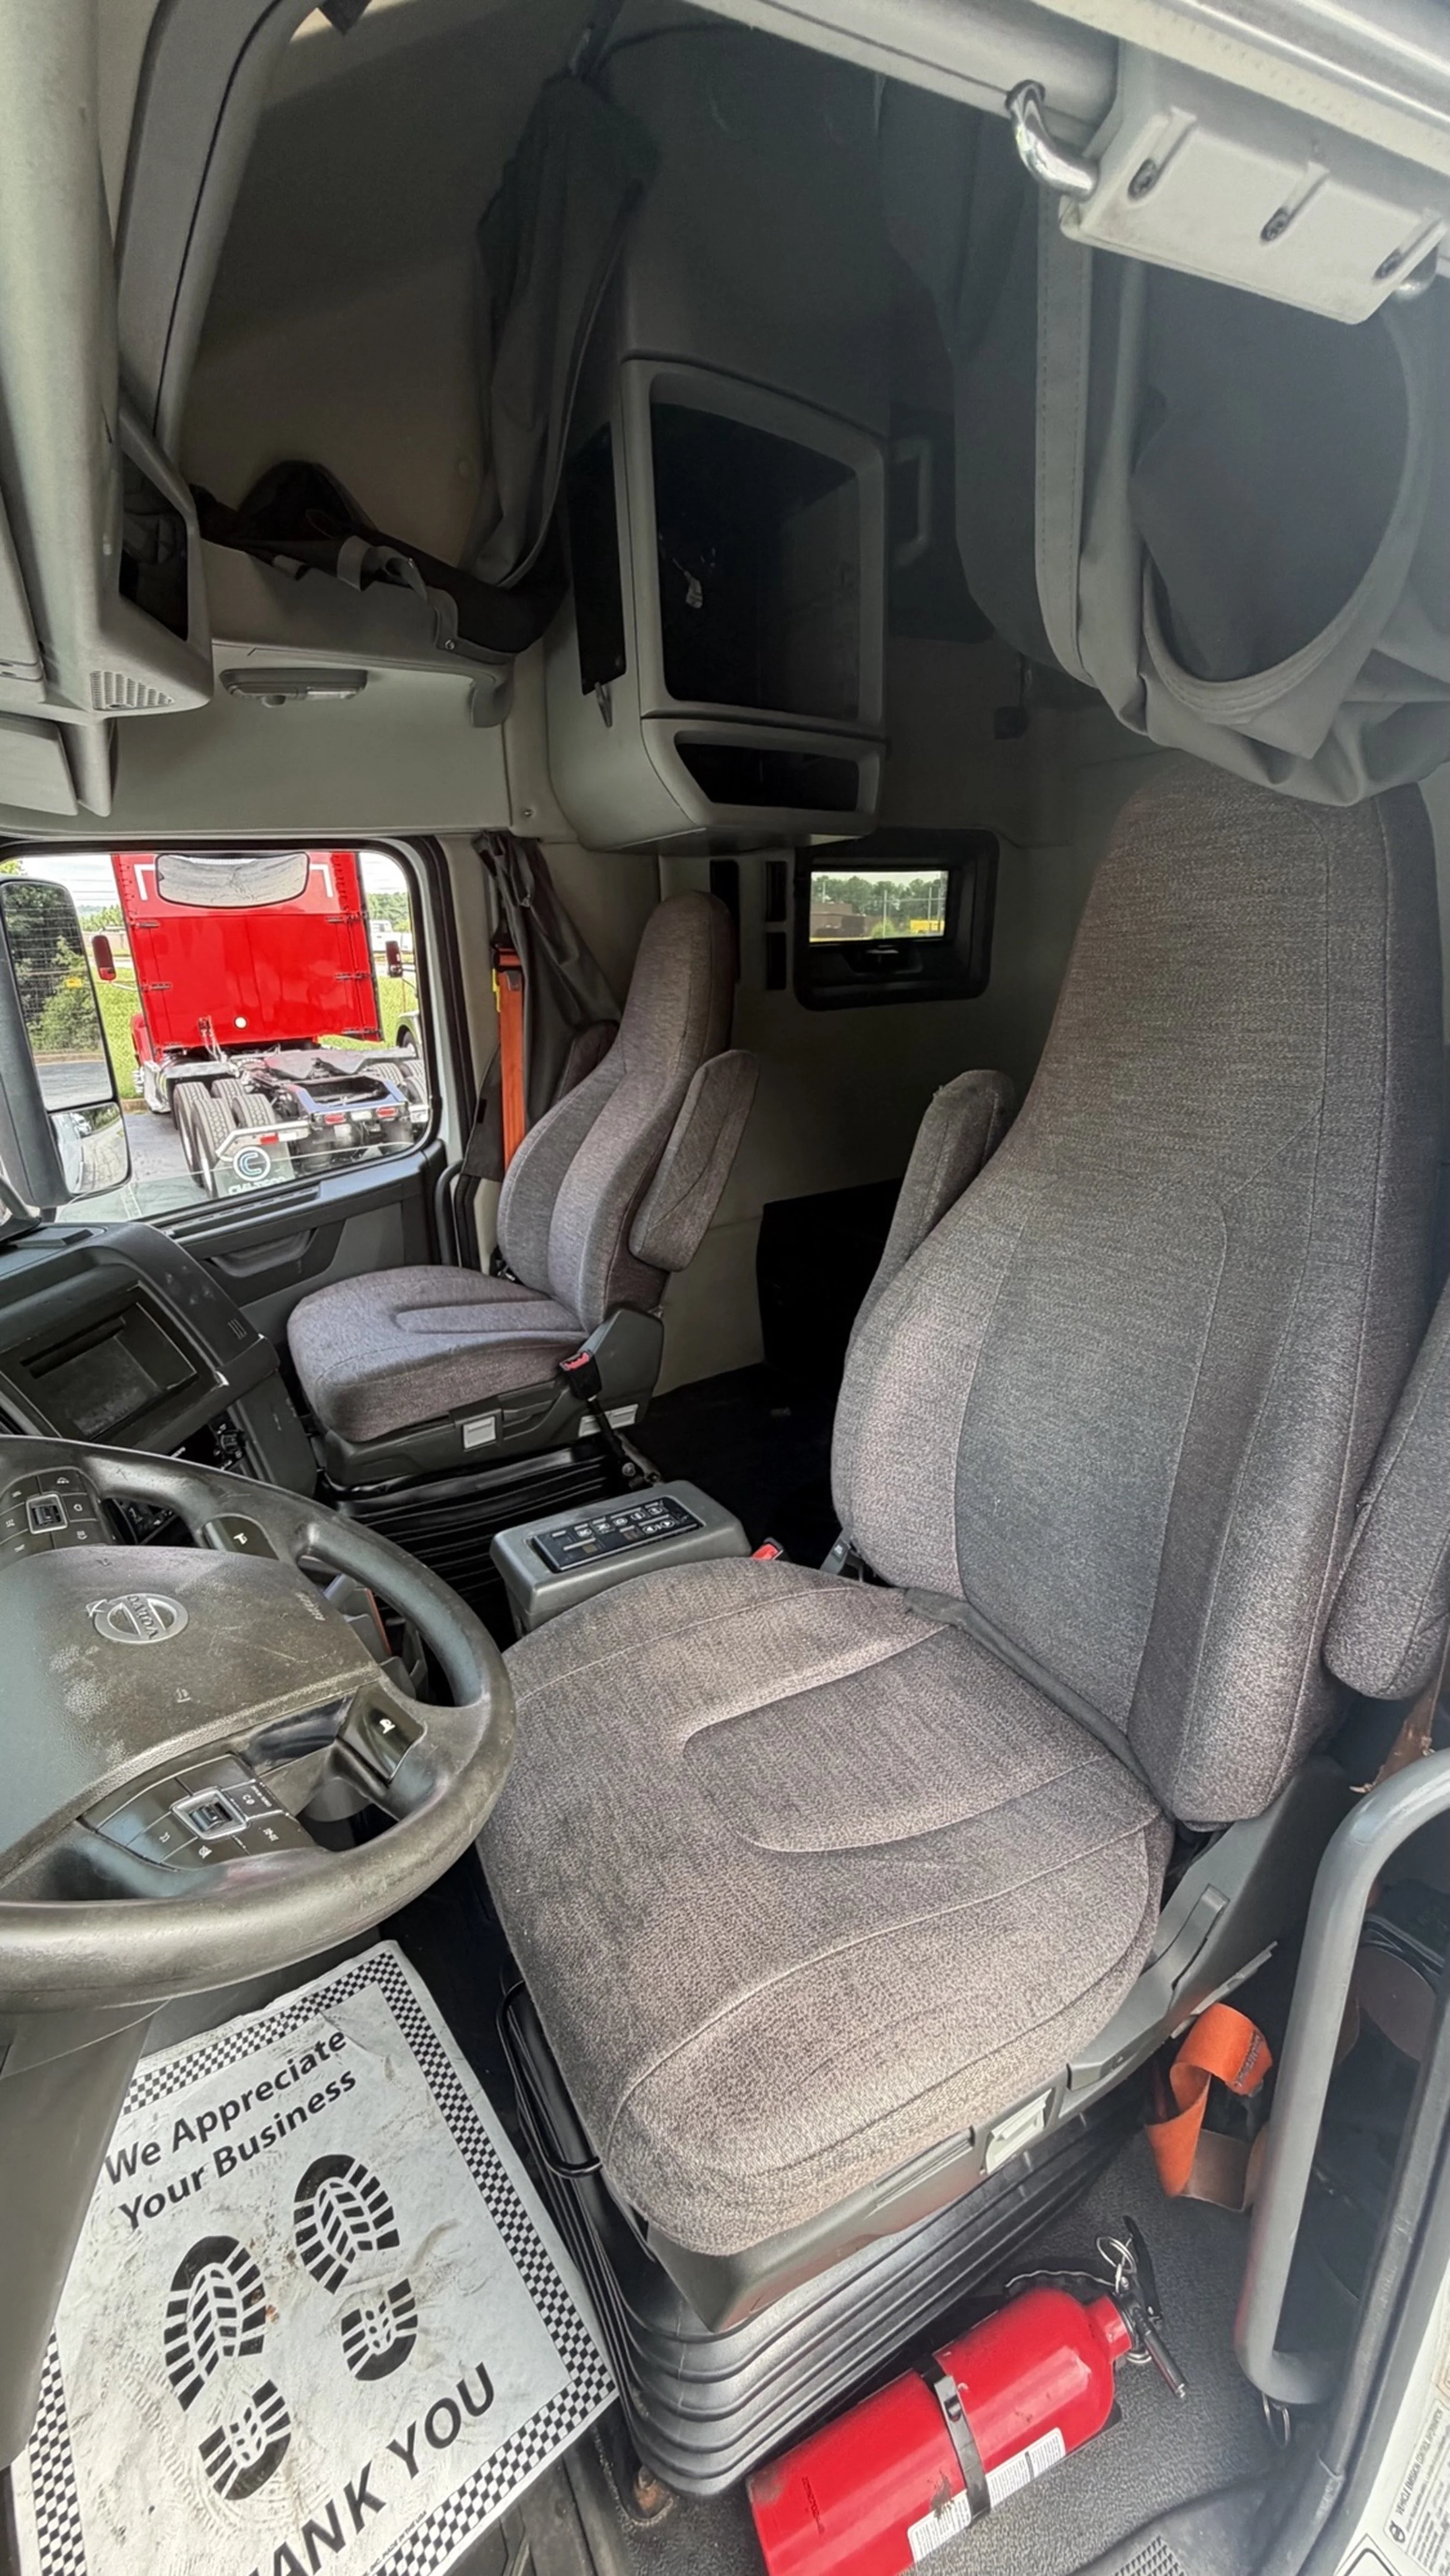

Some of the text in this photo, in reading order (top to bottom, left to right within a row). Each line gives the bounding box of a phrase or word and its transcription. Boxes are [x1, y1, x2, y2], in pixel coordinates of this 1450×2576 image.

[127, 1595, 159, 1640] VOLVO
[104, 2031, 347, 2185] We Appreciate
[118, 2070, 357, 2230] Your Business
[248, 2361, 494, 2576] ANK YOU
